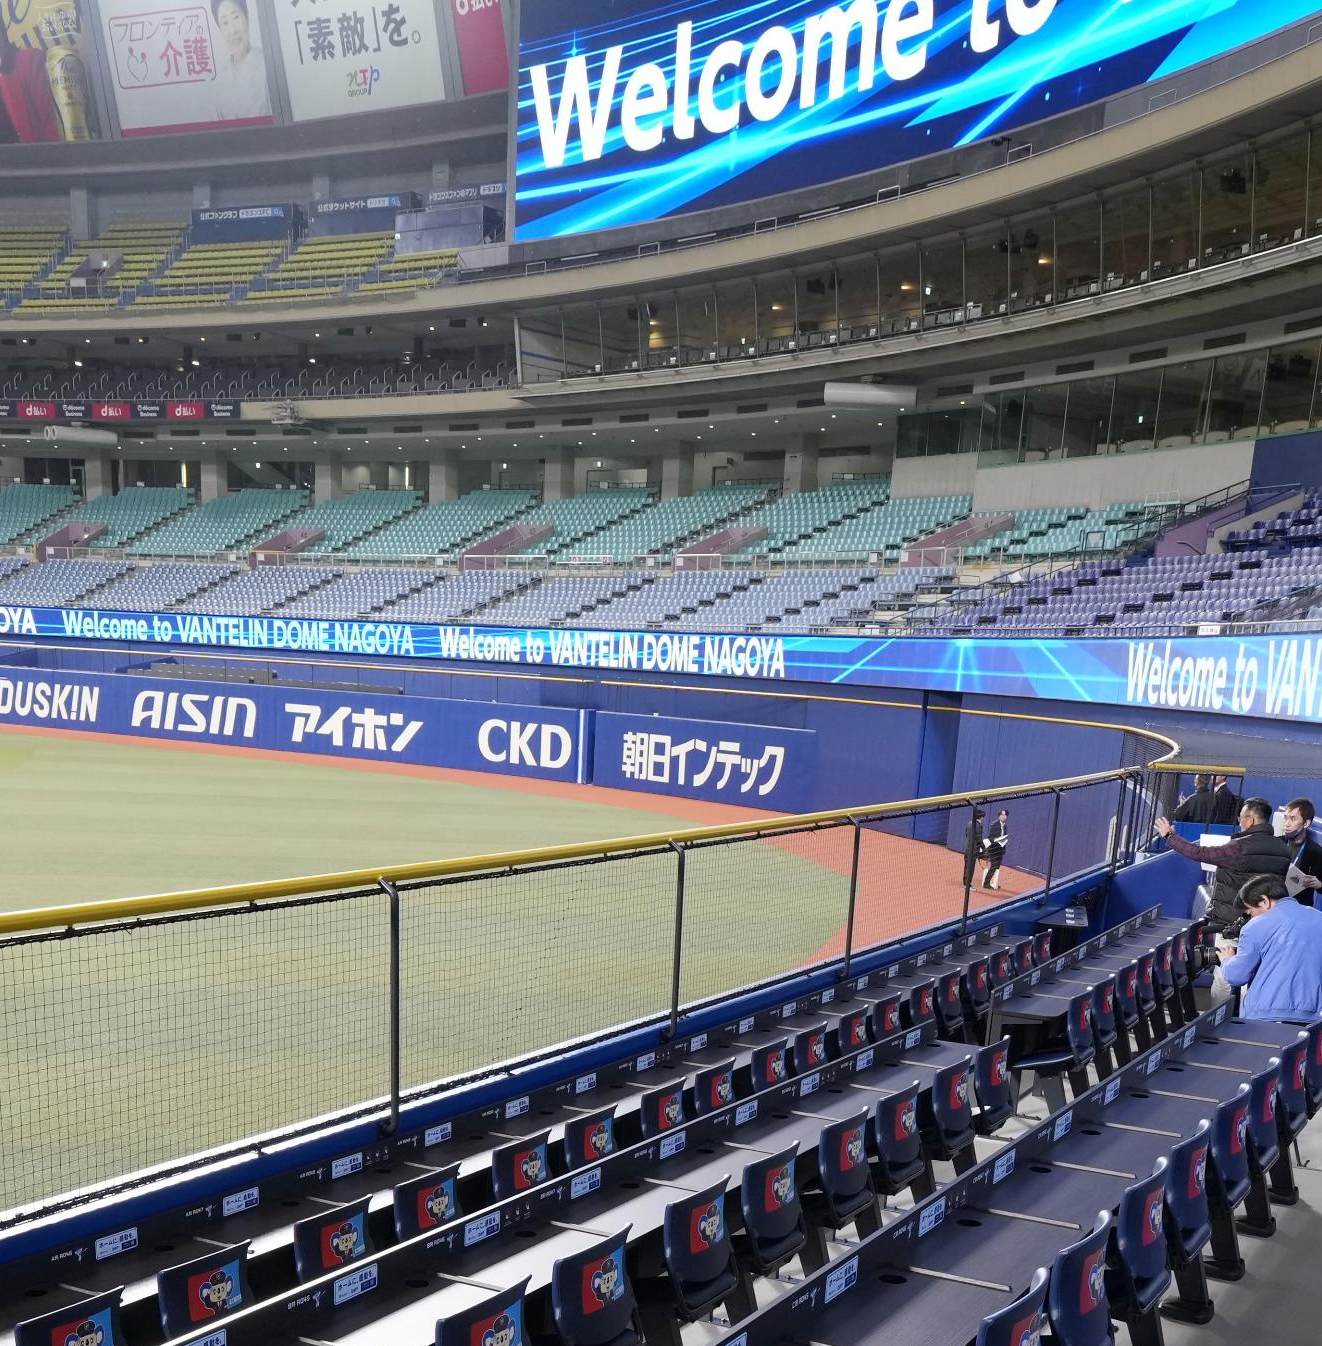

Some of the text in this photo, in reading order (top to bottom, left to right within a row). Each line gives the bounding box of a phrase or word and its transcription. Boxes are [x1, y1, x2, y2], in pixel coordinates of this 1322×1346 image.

[114, 14, 205, 43] フロンティアの
[159, 36, 213, 77] 介護
[530, 0, 935, 168] Welcome
[62, 608, 415, 655] Welcome to VANTELIN DOME NAGOYA
[439, 626, 786, 678] Welcome to VANTELIN DOME NAGOYA
[1126, 642, 1228, 711] Welcome
[1232, 645, 1258, 713] to
[131, 689, 256, 738] AISIN
[285, 702, 425, 753] アイホン
[478, 717, 572, 769] CKD
[621, 730, 786, 797] 朝日インテック
